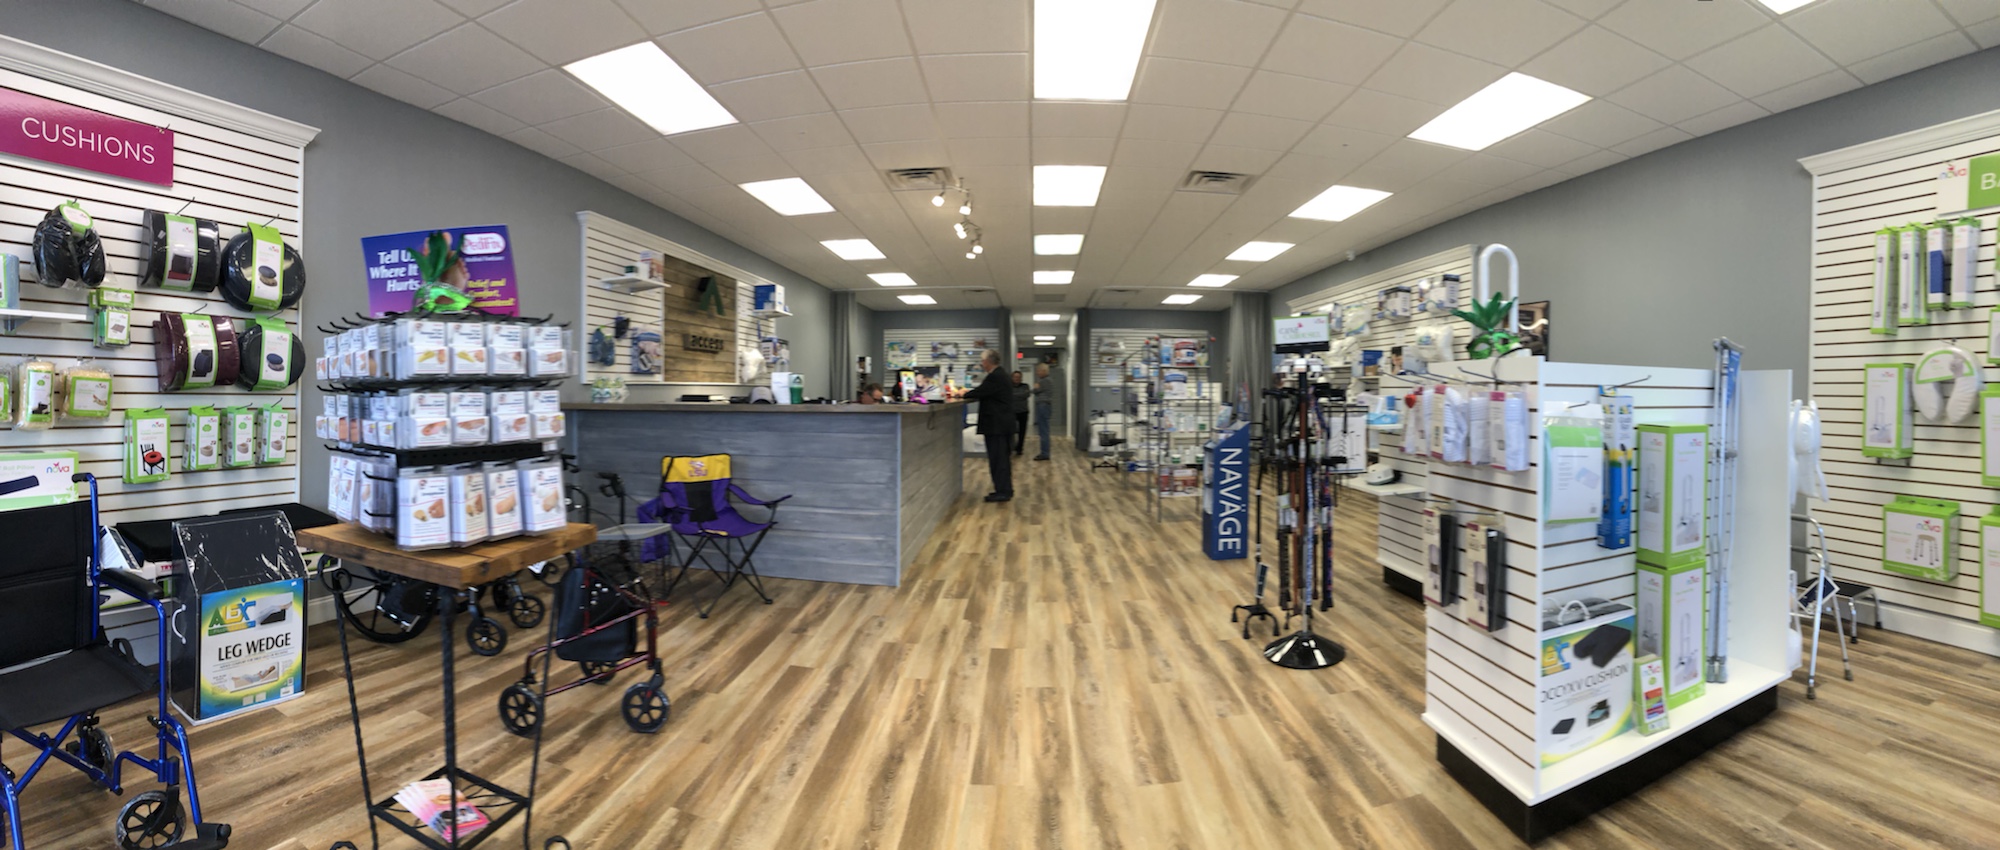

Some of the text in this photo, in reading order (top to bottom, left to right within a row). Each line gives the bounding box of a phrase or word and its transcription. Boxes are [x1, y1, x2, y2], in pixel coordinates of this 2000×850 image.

[22, 117, 155, 164] CUSHIONS
[1939, 167, 1967, 180] nova
[377, 249, 399, 265] Tell
[369, 265, 407, 279] Where
[46, 465, 70, 474] nova
[218, 632, 291, 661] LEG WEDGE
